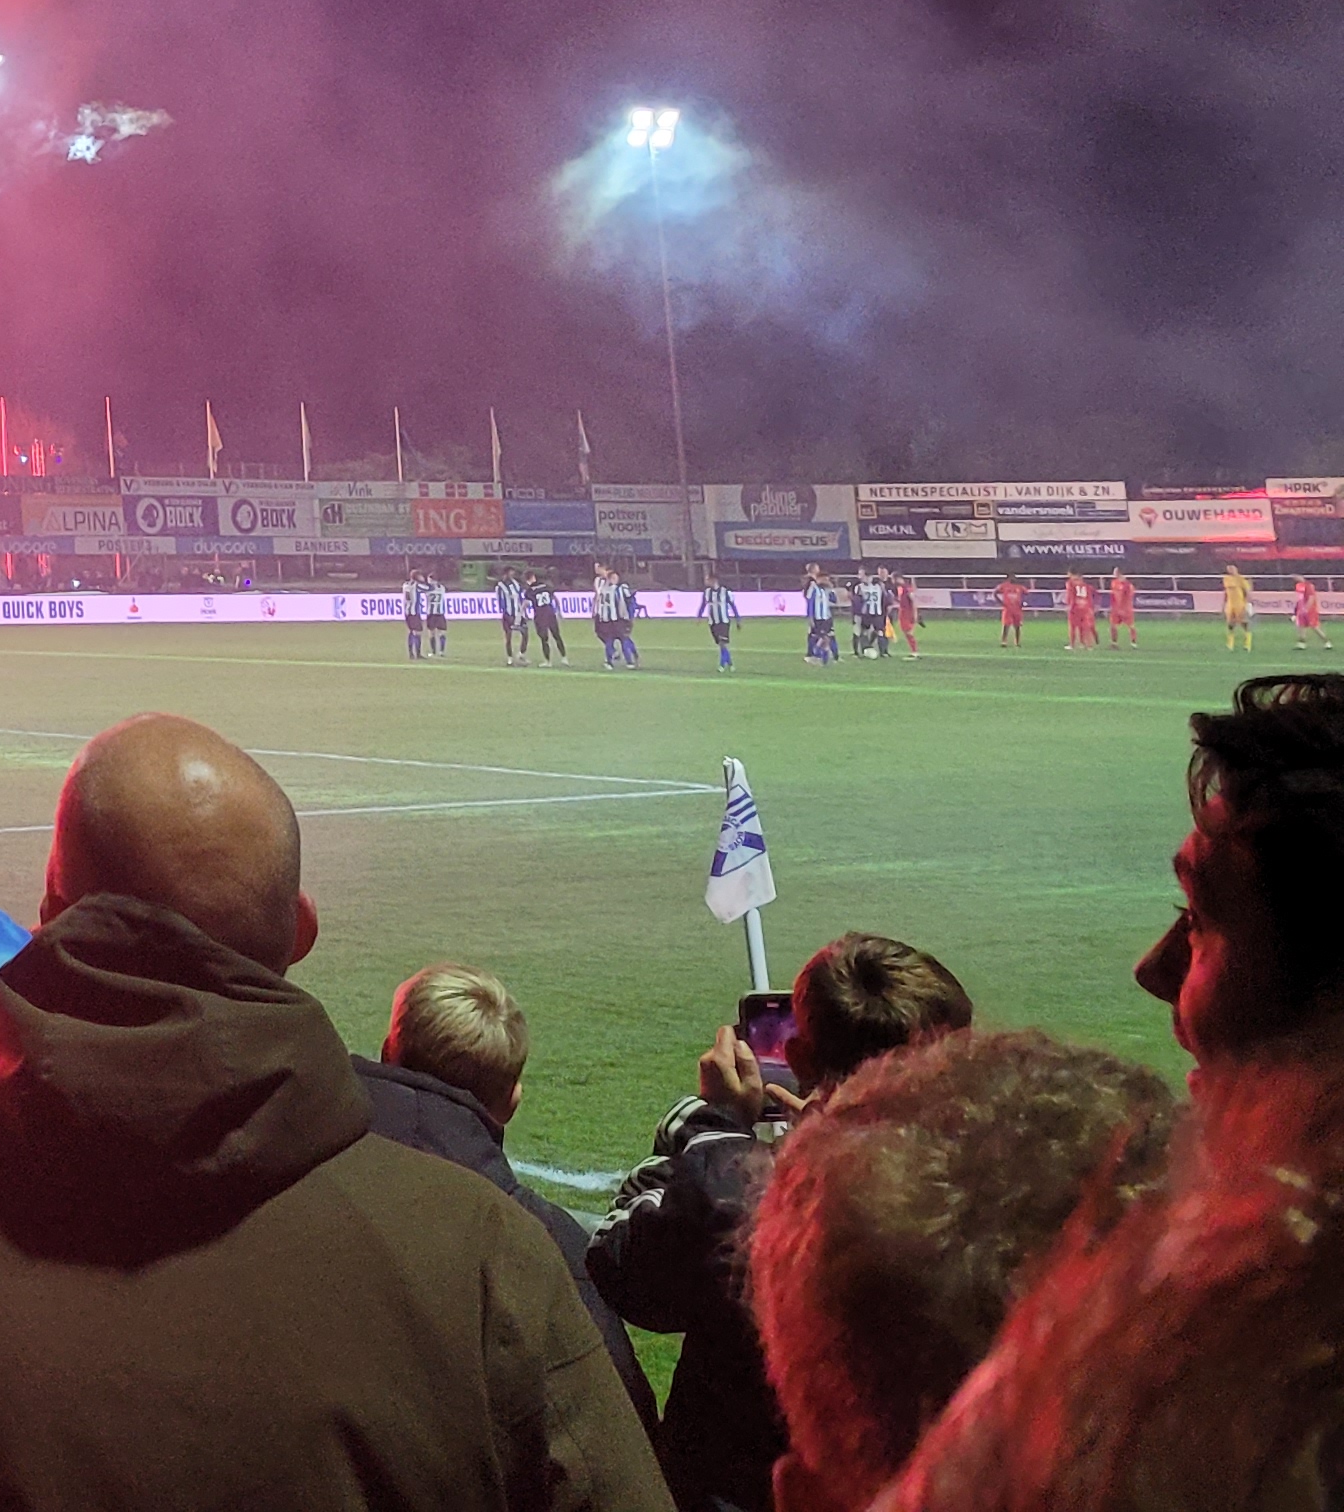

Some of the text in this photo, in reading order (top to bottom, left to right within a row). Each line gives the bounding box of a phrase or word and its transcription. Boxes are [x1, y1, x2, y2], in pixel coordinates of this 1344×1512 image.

[348, 480, 374, 497] Vink
[869, 486, 999, 498] NETTENSPECIALIST
[1017, 485, 1042, 497] VAN
[1046, 484, 1075, 497] DIJK
[1078, 484, 1088, 497] &
[165, 506, 204, 529] BOCK
[261, 507, 297, 530] BOCK
[415, 508, 468, 534] ING
[598, 508, 648, 523] potters
[1162, 508, 1263, 522] OUWEHAND
[295, 540, 350, 553] BANNERS
[482, 540, 533, 554] VLAGGEN
[734, 531, 829, 548] beddenreus
[1, 599, 46, 620] QUICK
[48, 598, 85, 619] BOYS
